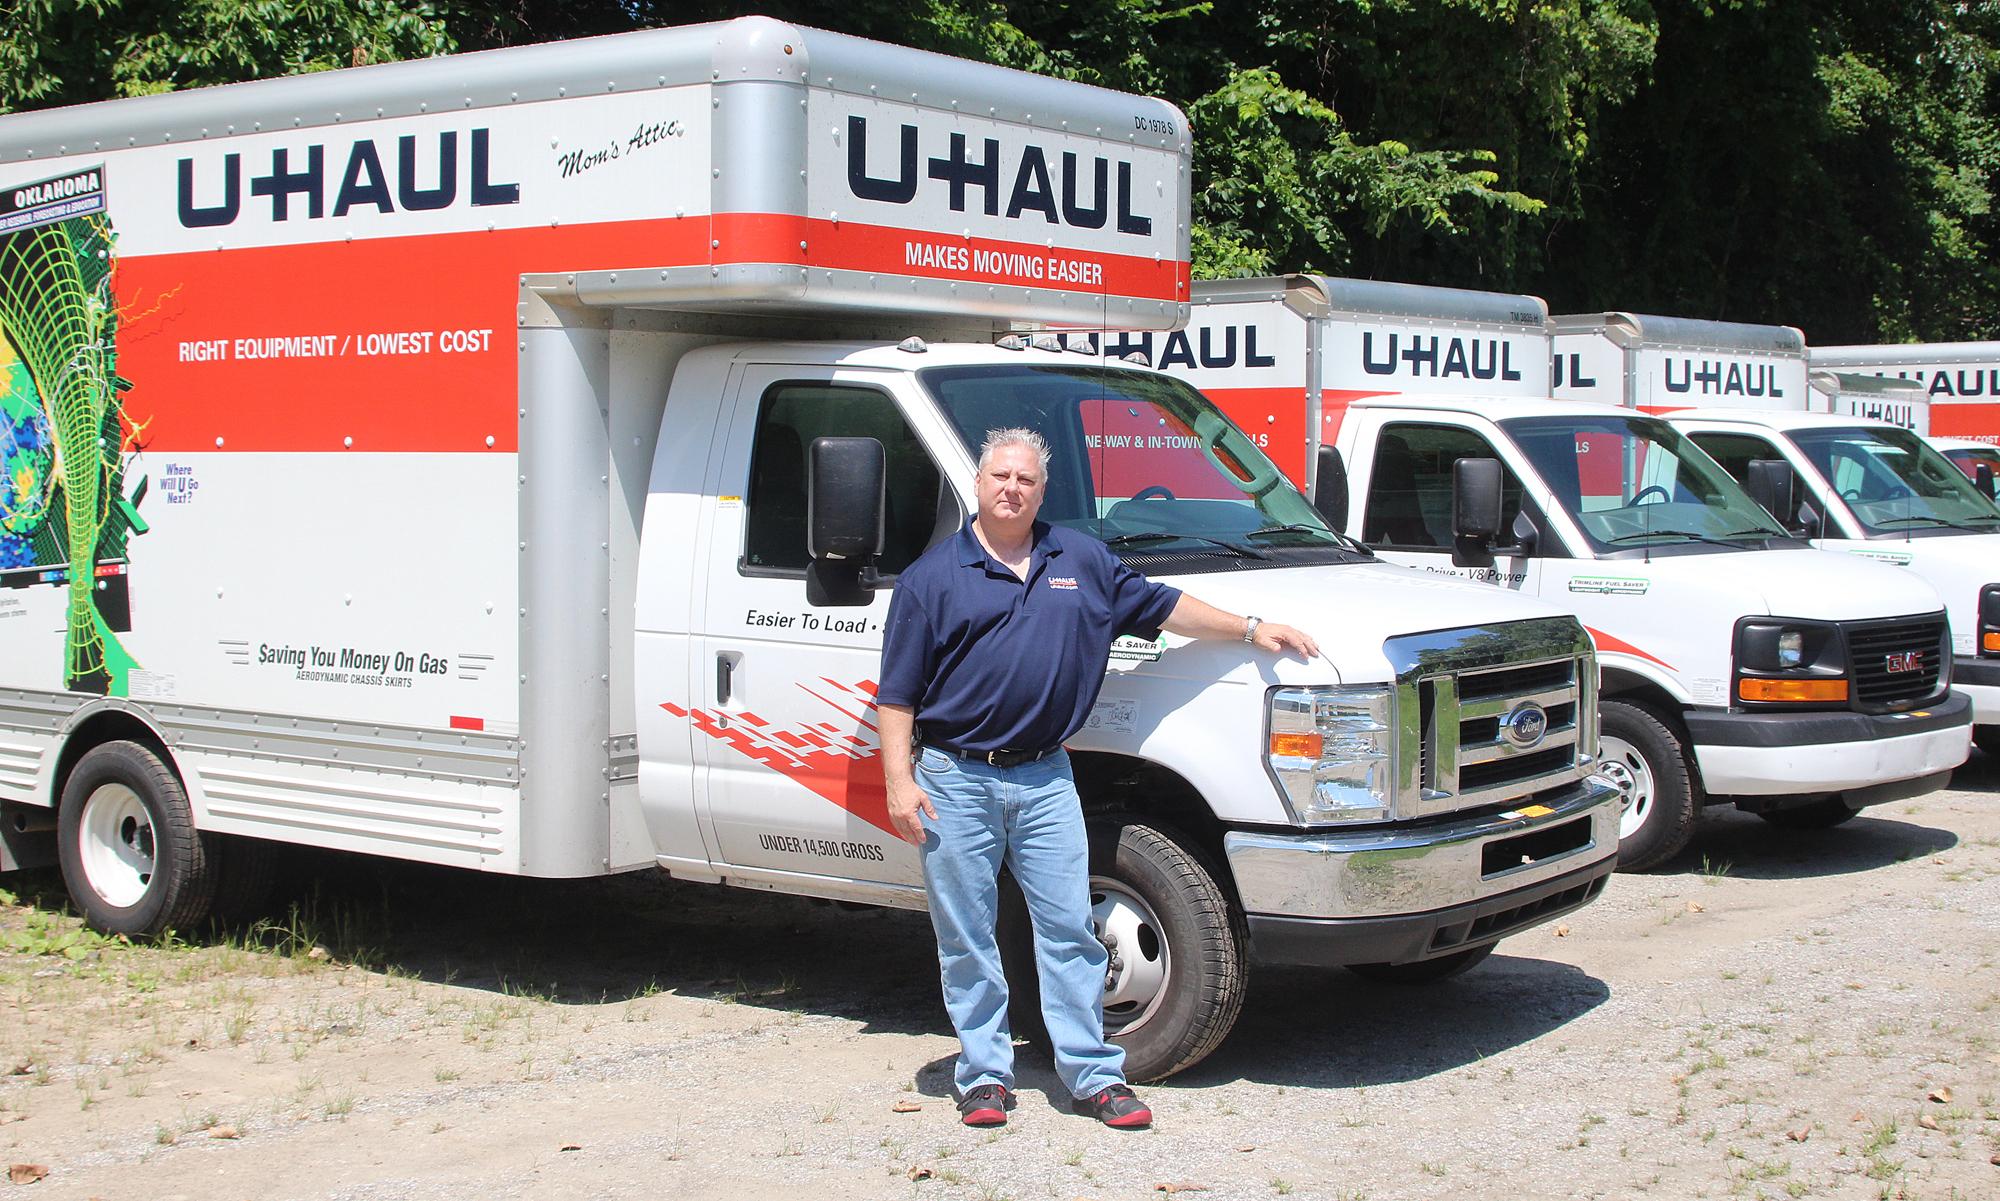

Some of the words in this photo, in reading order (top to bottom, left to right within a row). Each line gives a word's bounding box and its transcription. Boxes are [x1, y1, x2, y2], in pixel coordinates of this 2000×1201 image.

[1134, 116, 1147, 131] DC
[1149, 119, 1167, 134] 1978
[1168, 121, 1174, 135] S
[558, 140, 620, 178] Mom's
[626, 120, 678, 155] Attic
[178, 128, 520, 229] U-HAUL
[848, 115, 1152, 236] U-HAUL
[14, 172, 99, 209] OKLAHOMA
[905, 242, 969, 271] MAKES
[974, 250, 1043, 279] MOVING
[1048, 258, 1103, 285] EASIER
[179, 340, 228, 362] RIGHT
[234, 335, 336, 360] EQUIPMENT
[340, 335, 350, 356] /
[357, 332, 433, 356] LOWEST
[439, 329, 493, 353] COST
[1363, 332, 1521, 381] U-HAUL
[1665, 358, 1783, 398] U-HAUL
[1085, 435, 1131, 448] NE-WAY
[1134, 435, 1144, 448] &
[1148, 435, 1202, 449] IN-TOWN
[166, 463, 192, 475] Where
[160, 478, 176, 490] Will
[178, 477, 186, 492] U
[188, 478, 199, 490] Go
[167, 491, 193, 504] Next?
[1427, 566, 1456, 576] Dive
[1468, 568, 1484, 580] V8
[1487, 568, 1527, 583] Power
[746, 610, 796, 628] Easier
[801, 613, 819, 630] To
[825, 615, 867, 634] Load
[1109, 651, 1157, 661] AERODYNAMIC
[1111, 640, 1123, 648] EL
[1126, 640, 1158, 650] SAVER
[310, 646, 335, 668] You
[340, 648, 388, 675] Money
[394, 651, 414, 673] On
[419, 652, 448, 675] Gas
[1886, 652, 1924, 673] GMC
[296, 670, 349, 684] AERODYNAMIC
[350, 673, 383, 686] CHASSIS
[385, 675, 412, 688] SKIRTS
[1521, 715, 1541, 734] Ford
[759, 834, 802, 854] UNDER
[803, 838, 840, 857] 14,500
[841, 842, 885, 862] GROSS
